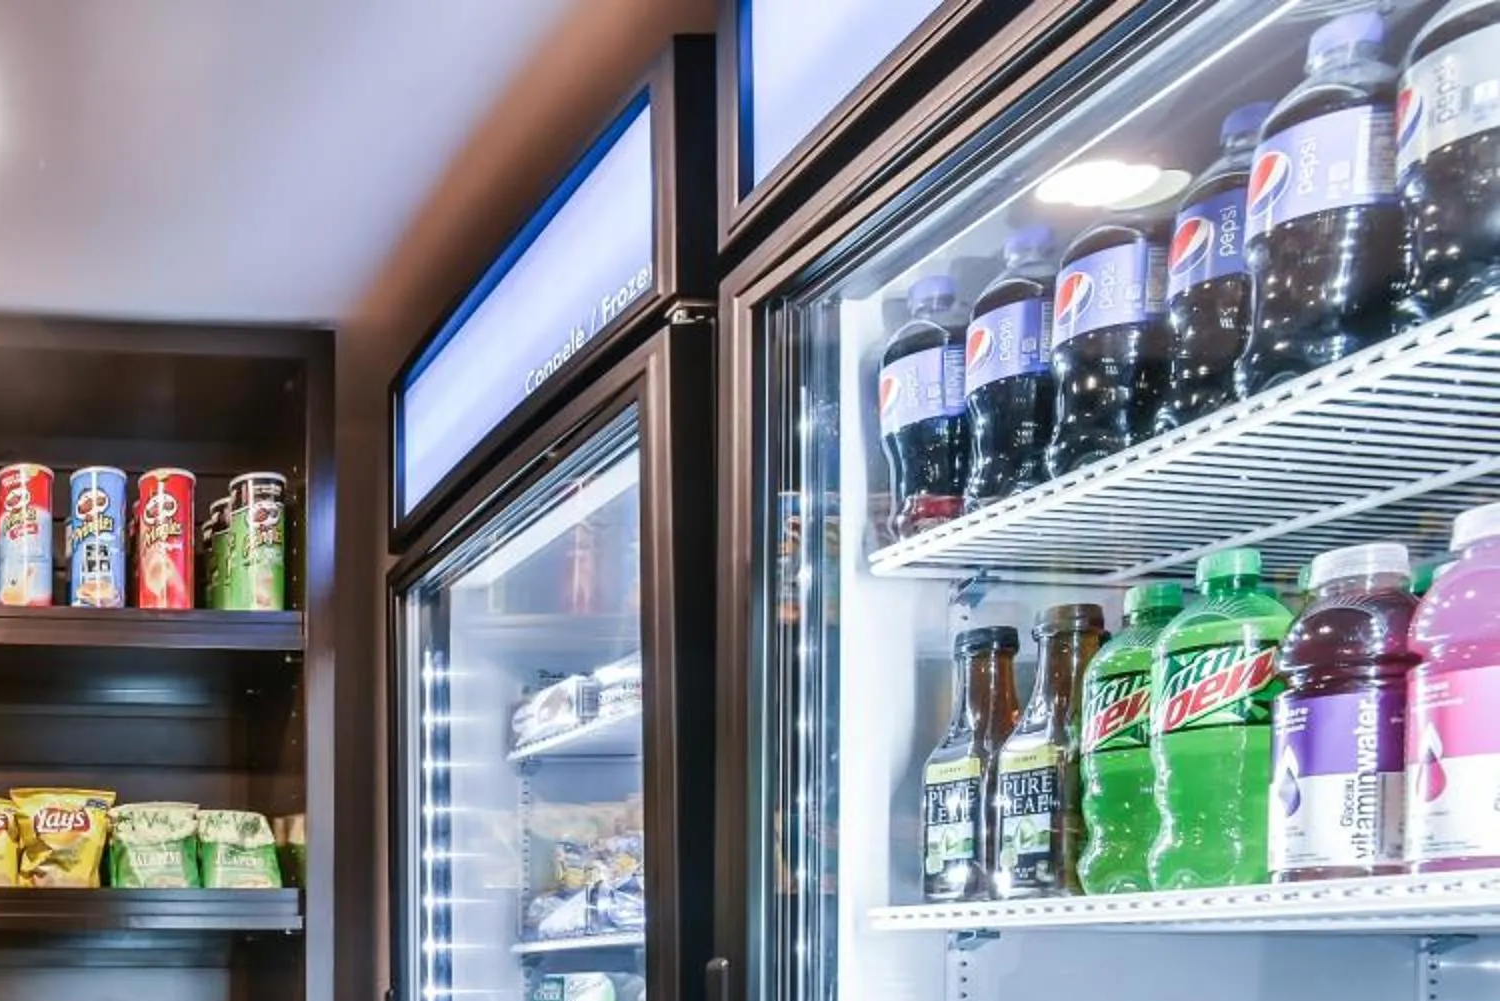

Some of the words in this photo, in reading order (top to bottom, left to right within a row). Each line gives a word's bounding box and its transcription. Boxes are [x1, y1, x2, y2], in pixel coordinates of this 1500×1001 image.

[1219, 204, 1237, 257] pepsi
[1002, 774, 1054, 799] PURE
[1351, 692, 1380, 863] vitaminwater
